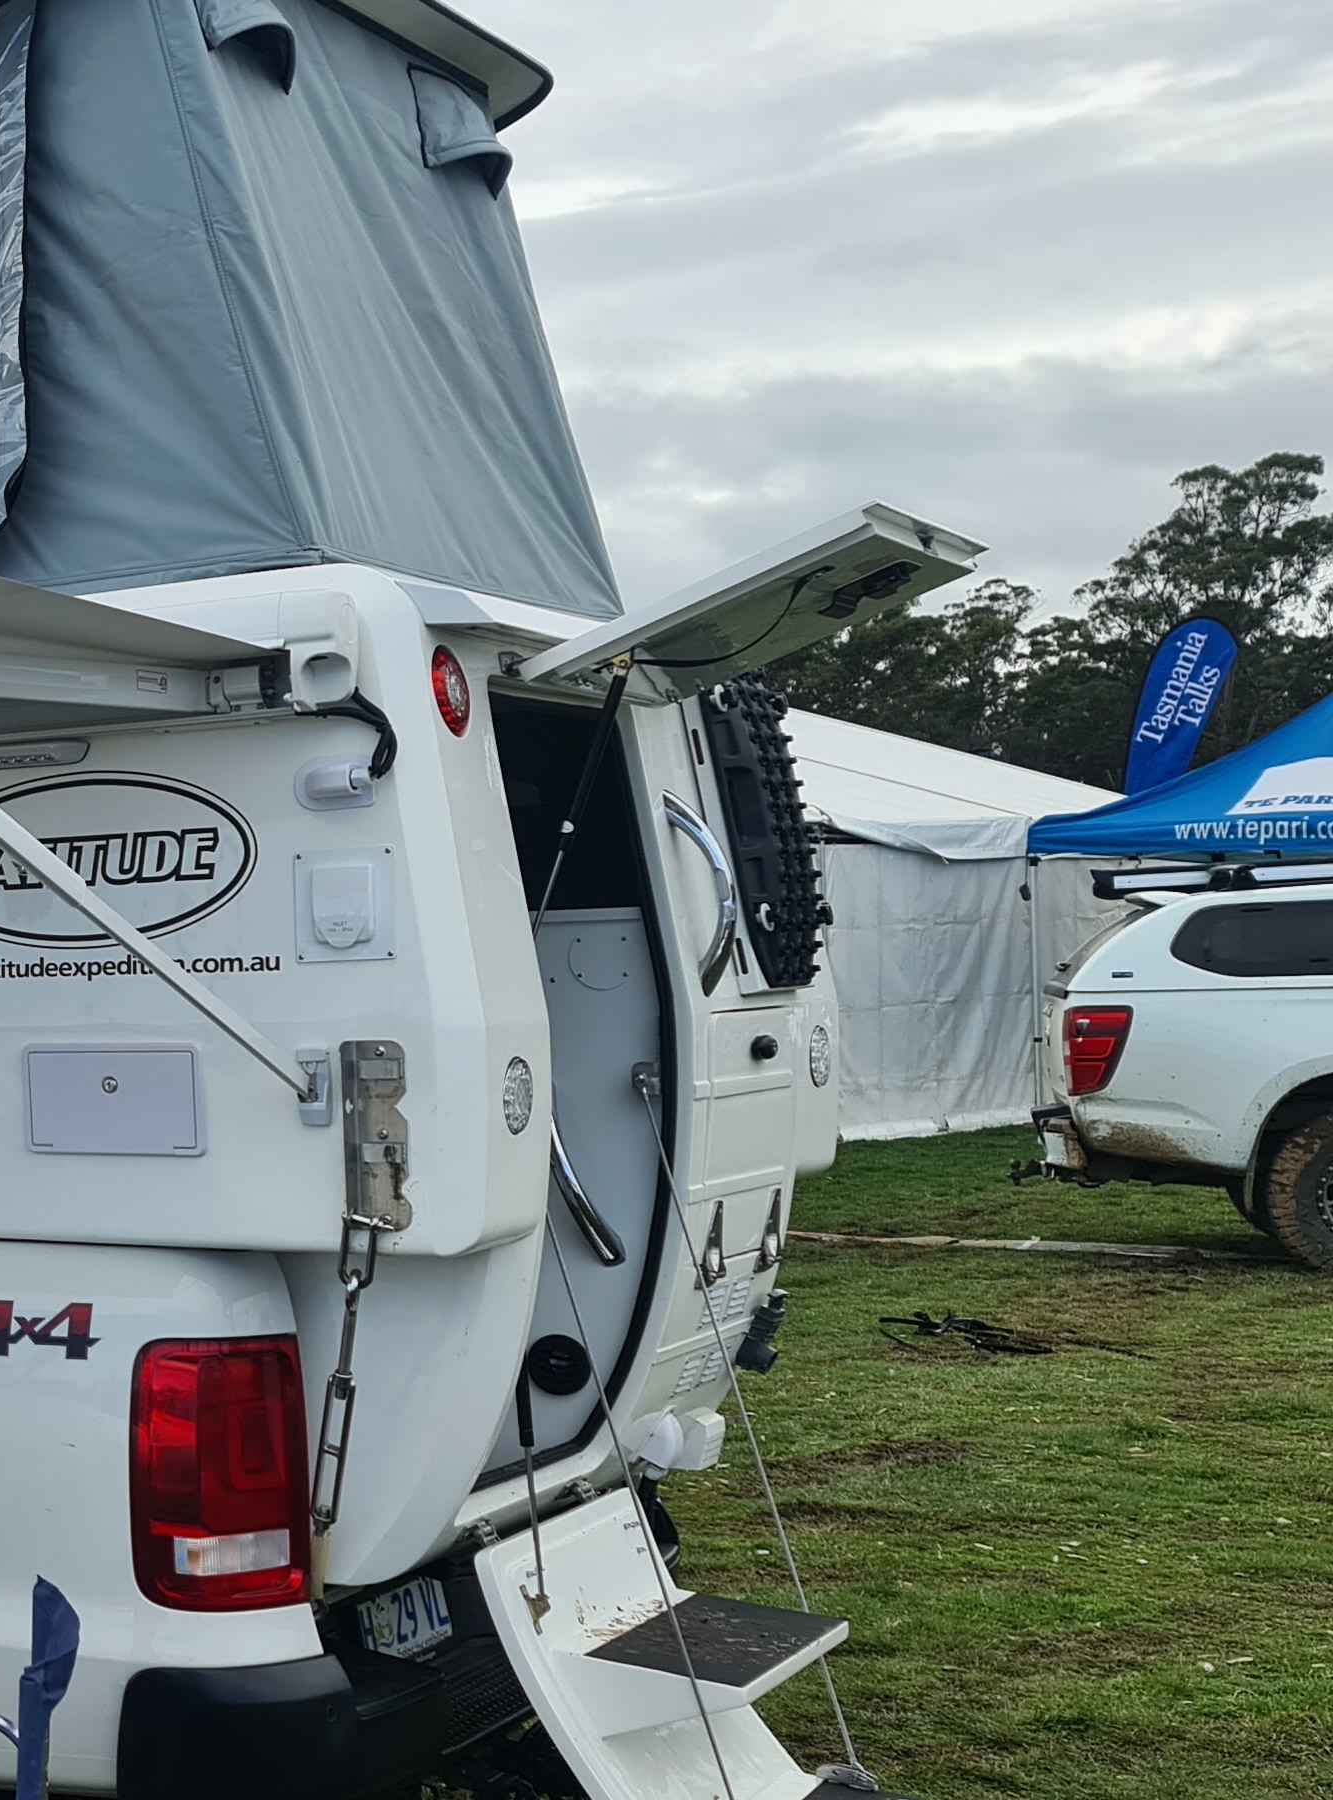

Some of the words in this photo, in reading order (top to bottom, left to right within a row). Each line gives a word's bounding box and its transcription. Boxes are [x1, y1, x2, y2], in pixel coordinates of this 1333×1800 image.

[1136, 632, 1209, 744] Tasmania
[1173, 665, 1221, 728] Talks
[1244, 797, 1279, 809] TE
[359, 1605, 378, 1652] H
[390, 1587, 419, 1645] 29
[417, 1579, 450, 1632] VL
